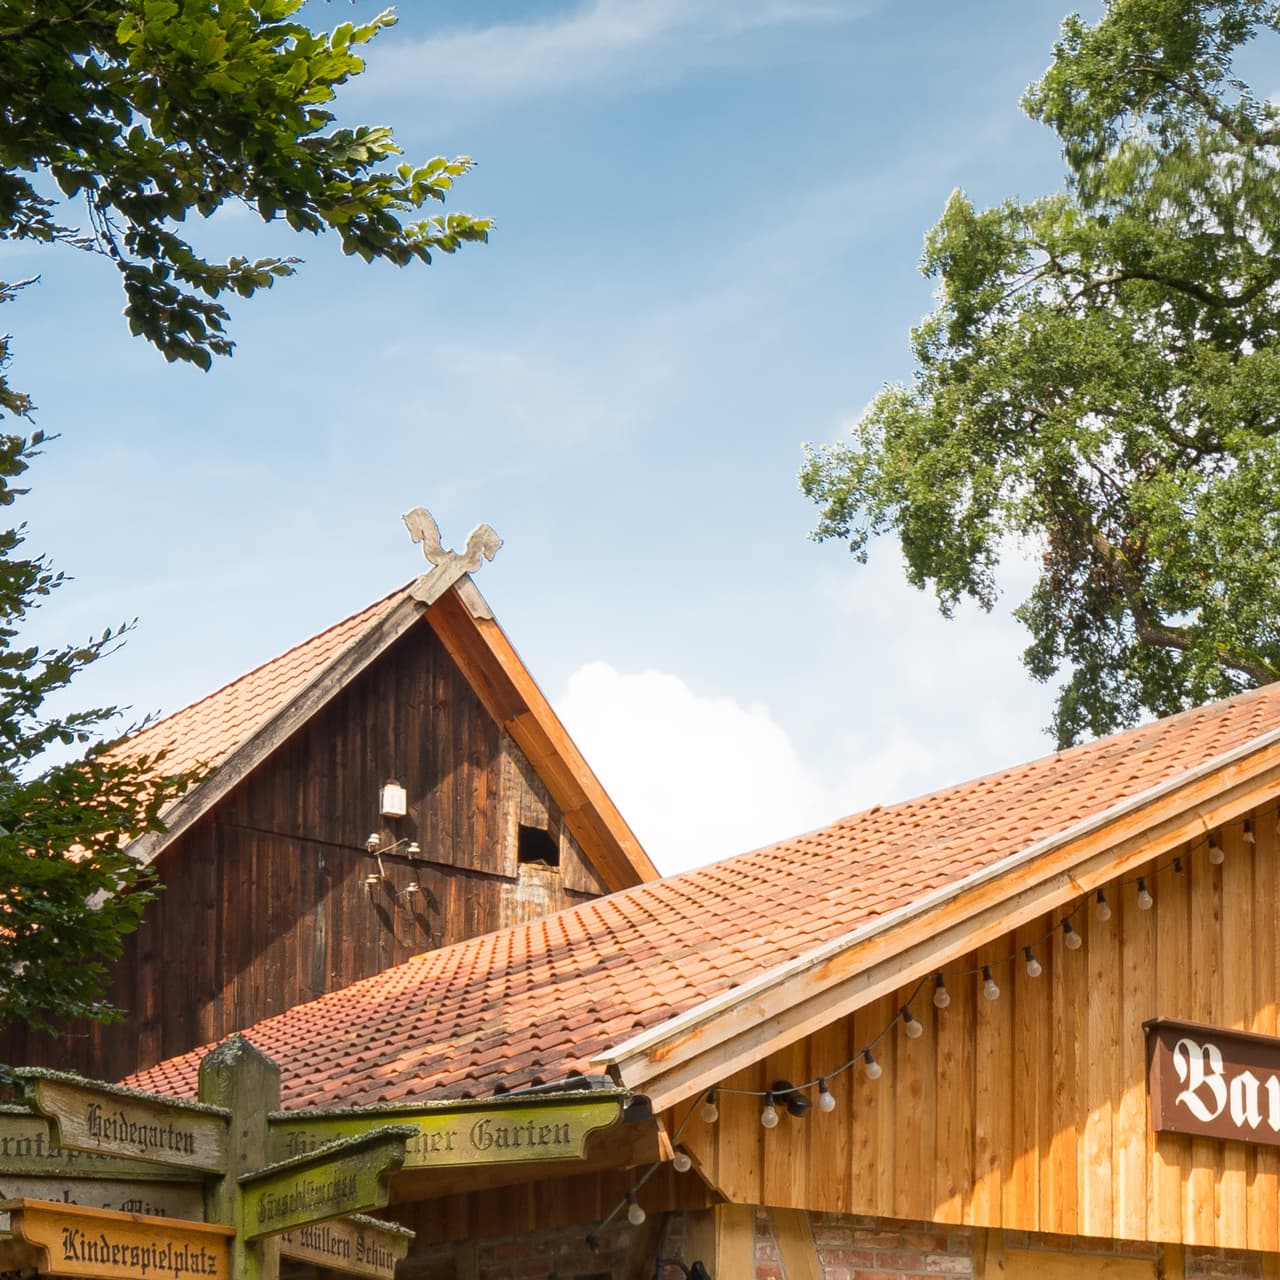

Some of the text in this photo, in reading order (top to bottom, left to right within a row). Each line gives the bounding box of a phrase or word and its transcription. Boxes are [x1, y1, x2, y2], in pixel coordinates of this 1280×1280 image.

[87, 1103, 196, 1155] Heidegarten
[470, 1118, 571, 1151] Garten
[61, 1227, 218, 1279] Kinderspielplatz
[301, 1224, 394, 1271] Müllern Schün
